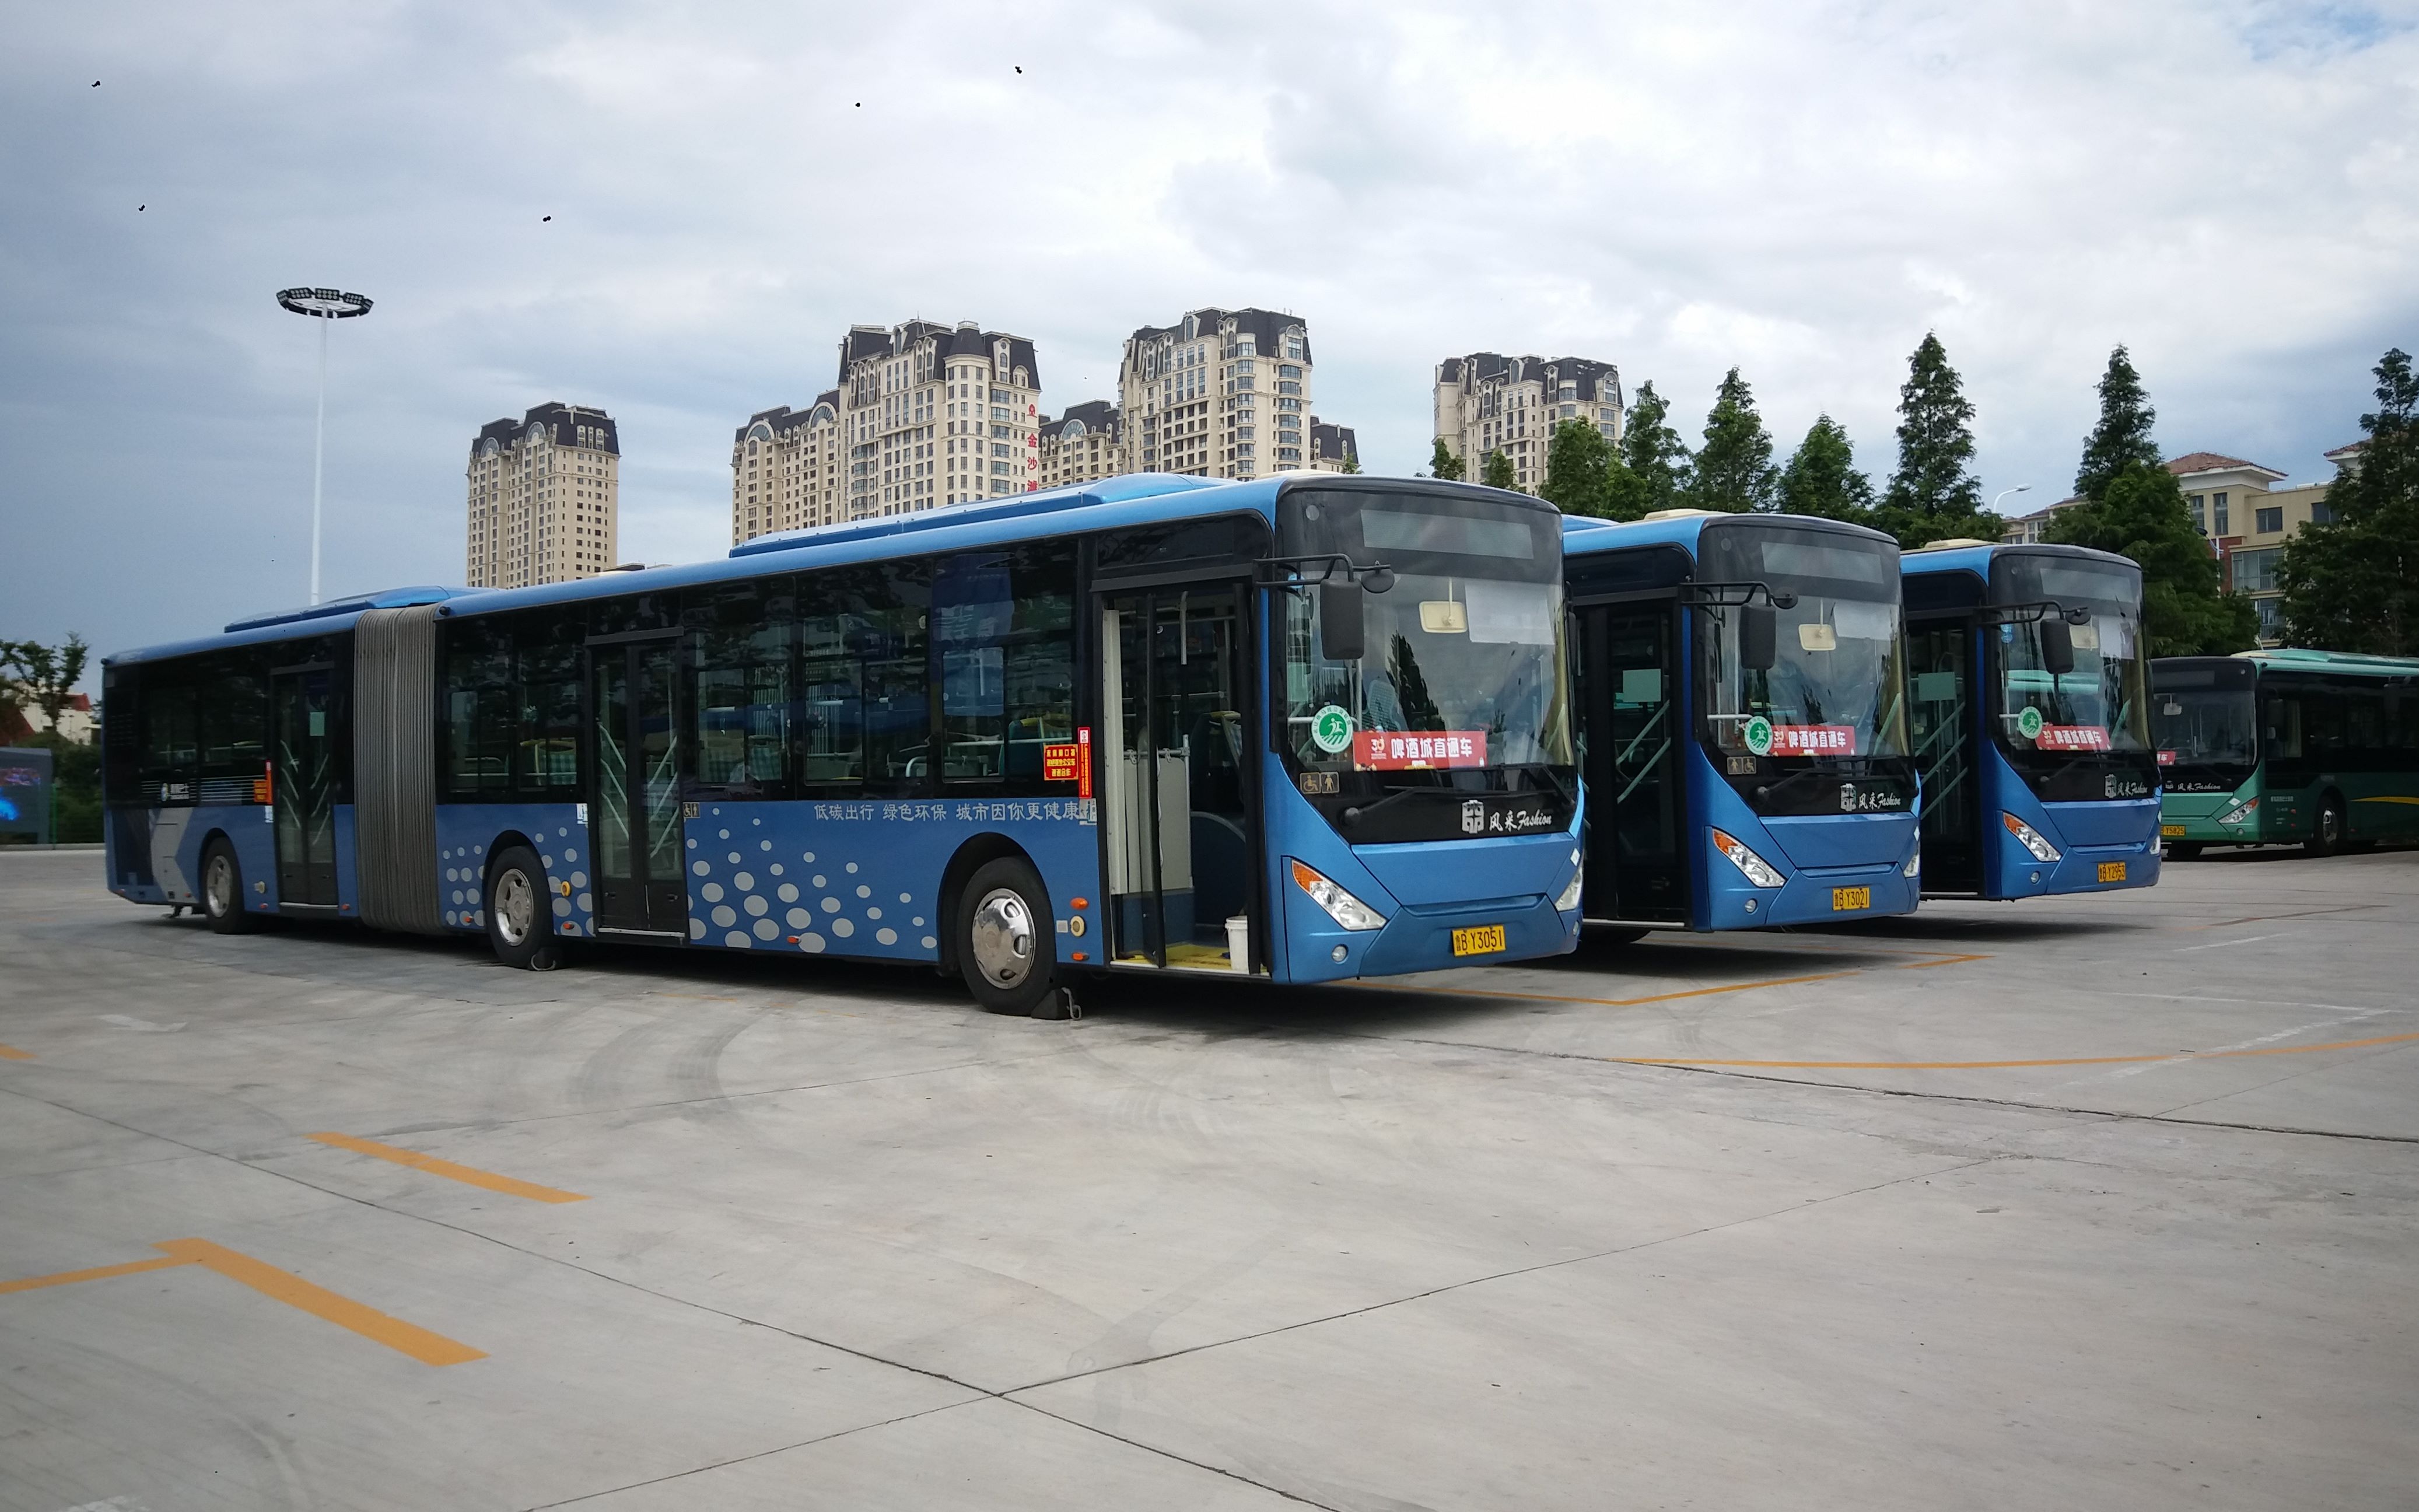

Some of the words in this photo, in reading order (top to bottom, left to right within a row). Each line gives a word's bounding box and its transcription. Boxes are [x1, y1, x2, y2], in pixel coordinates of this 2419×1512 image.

[1788, 730, 1846, 748] 啤酒城直通车
[2054, 730, 2102, 744] 啤酒城直通车
[1391, 737, 1473, 758] 啤酒城直通车
[1877, 792, 1901, 809] Fashion
[814, 804, 874, 821] 低碳出行
[883, 803, 947, 821] 绿色环保
[956, 801, 1079, 821] 城市因你更健康
[1489, 810, 1517, 832] 风采
[1517, 809, 1552, 831] Fashion
